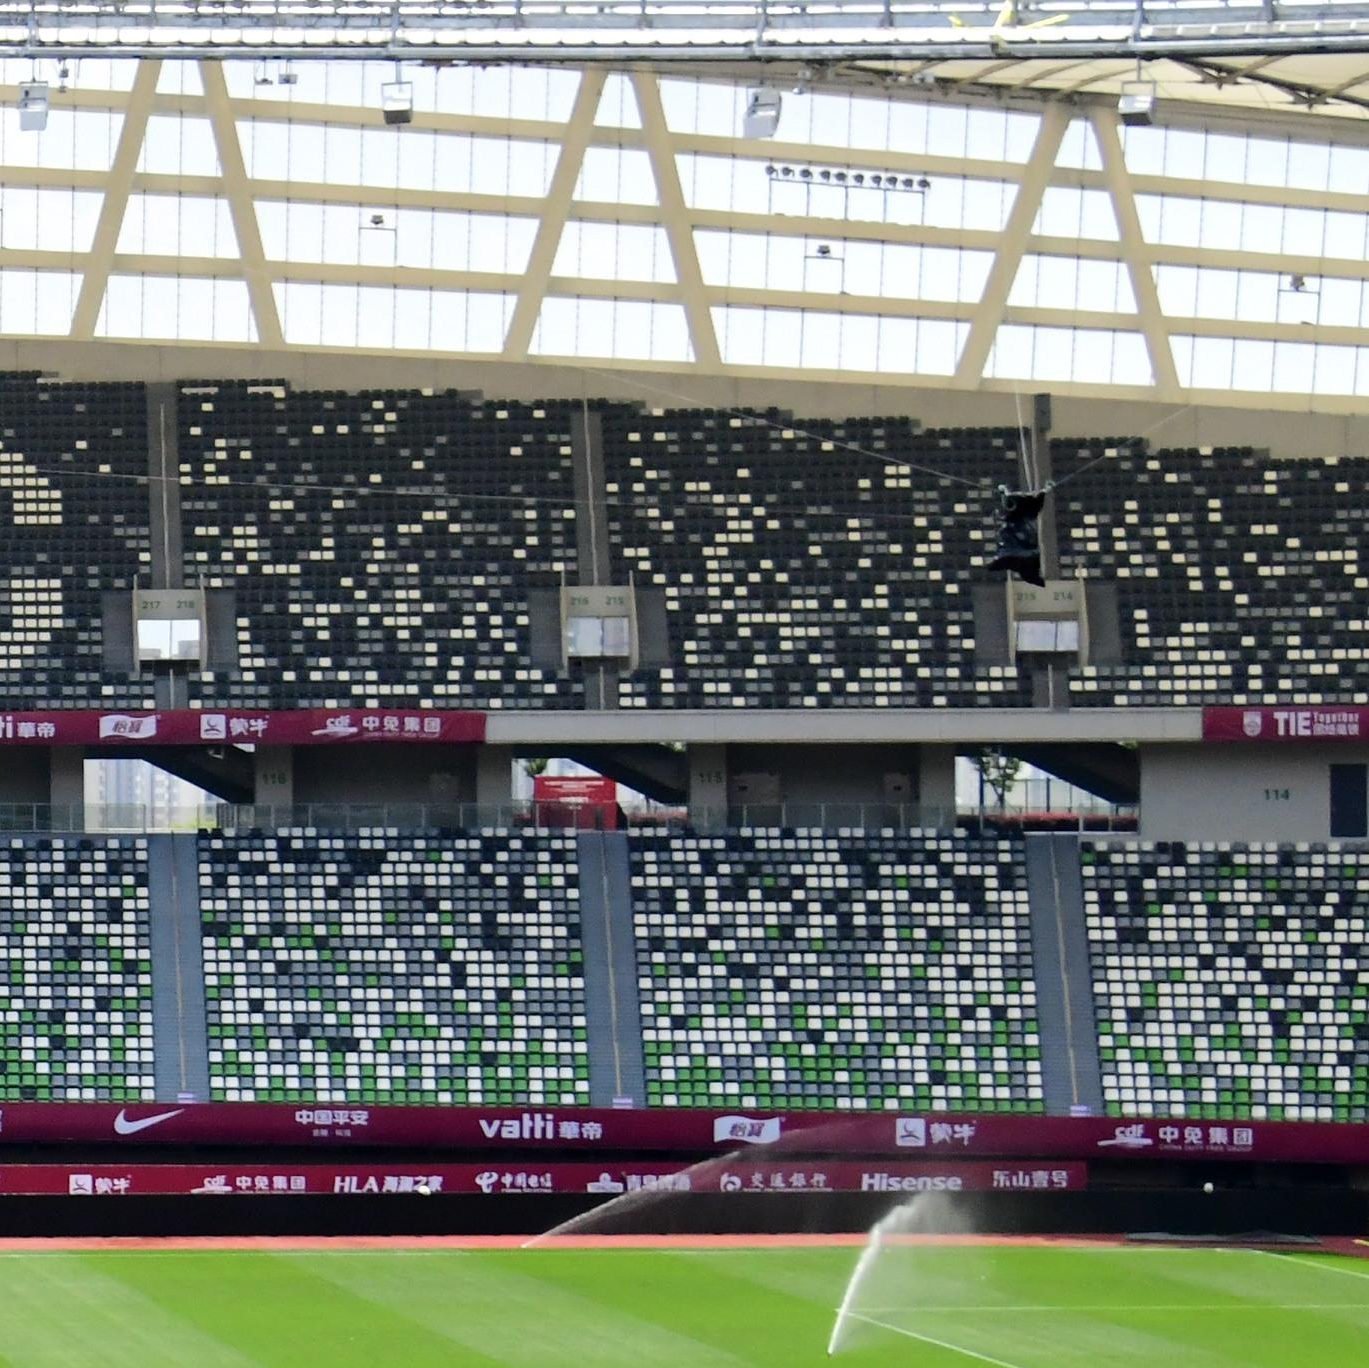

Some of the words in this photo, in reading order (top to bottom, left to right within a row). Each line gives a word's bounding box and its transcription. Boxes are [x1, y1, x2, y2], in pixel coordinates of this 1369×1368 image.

[229, 717, 268, 737] 蒙牛
[362, 715, 441, 732] 中免集团
[1273, 711, 1311, 736] TIE
[1264, 789, 1290, 801] 114
[295, 1109, 369, 1126] 中国平安
[479, 1112, 554, 1139] vatti
[1115, 1123, 1144, 1138] cdf
[1158, 1125, 1253, 1145] 中免集团
[235, 1175, 306, 1190] 中免集团
[333, 1175, 379, 1193] HLA
[861, 1172, 962, 1190] Hisense
[993, 1170, 1068, 1188] 东山壹号
